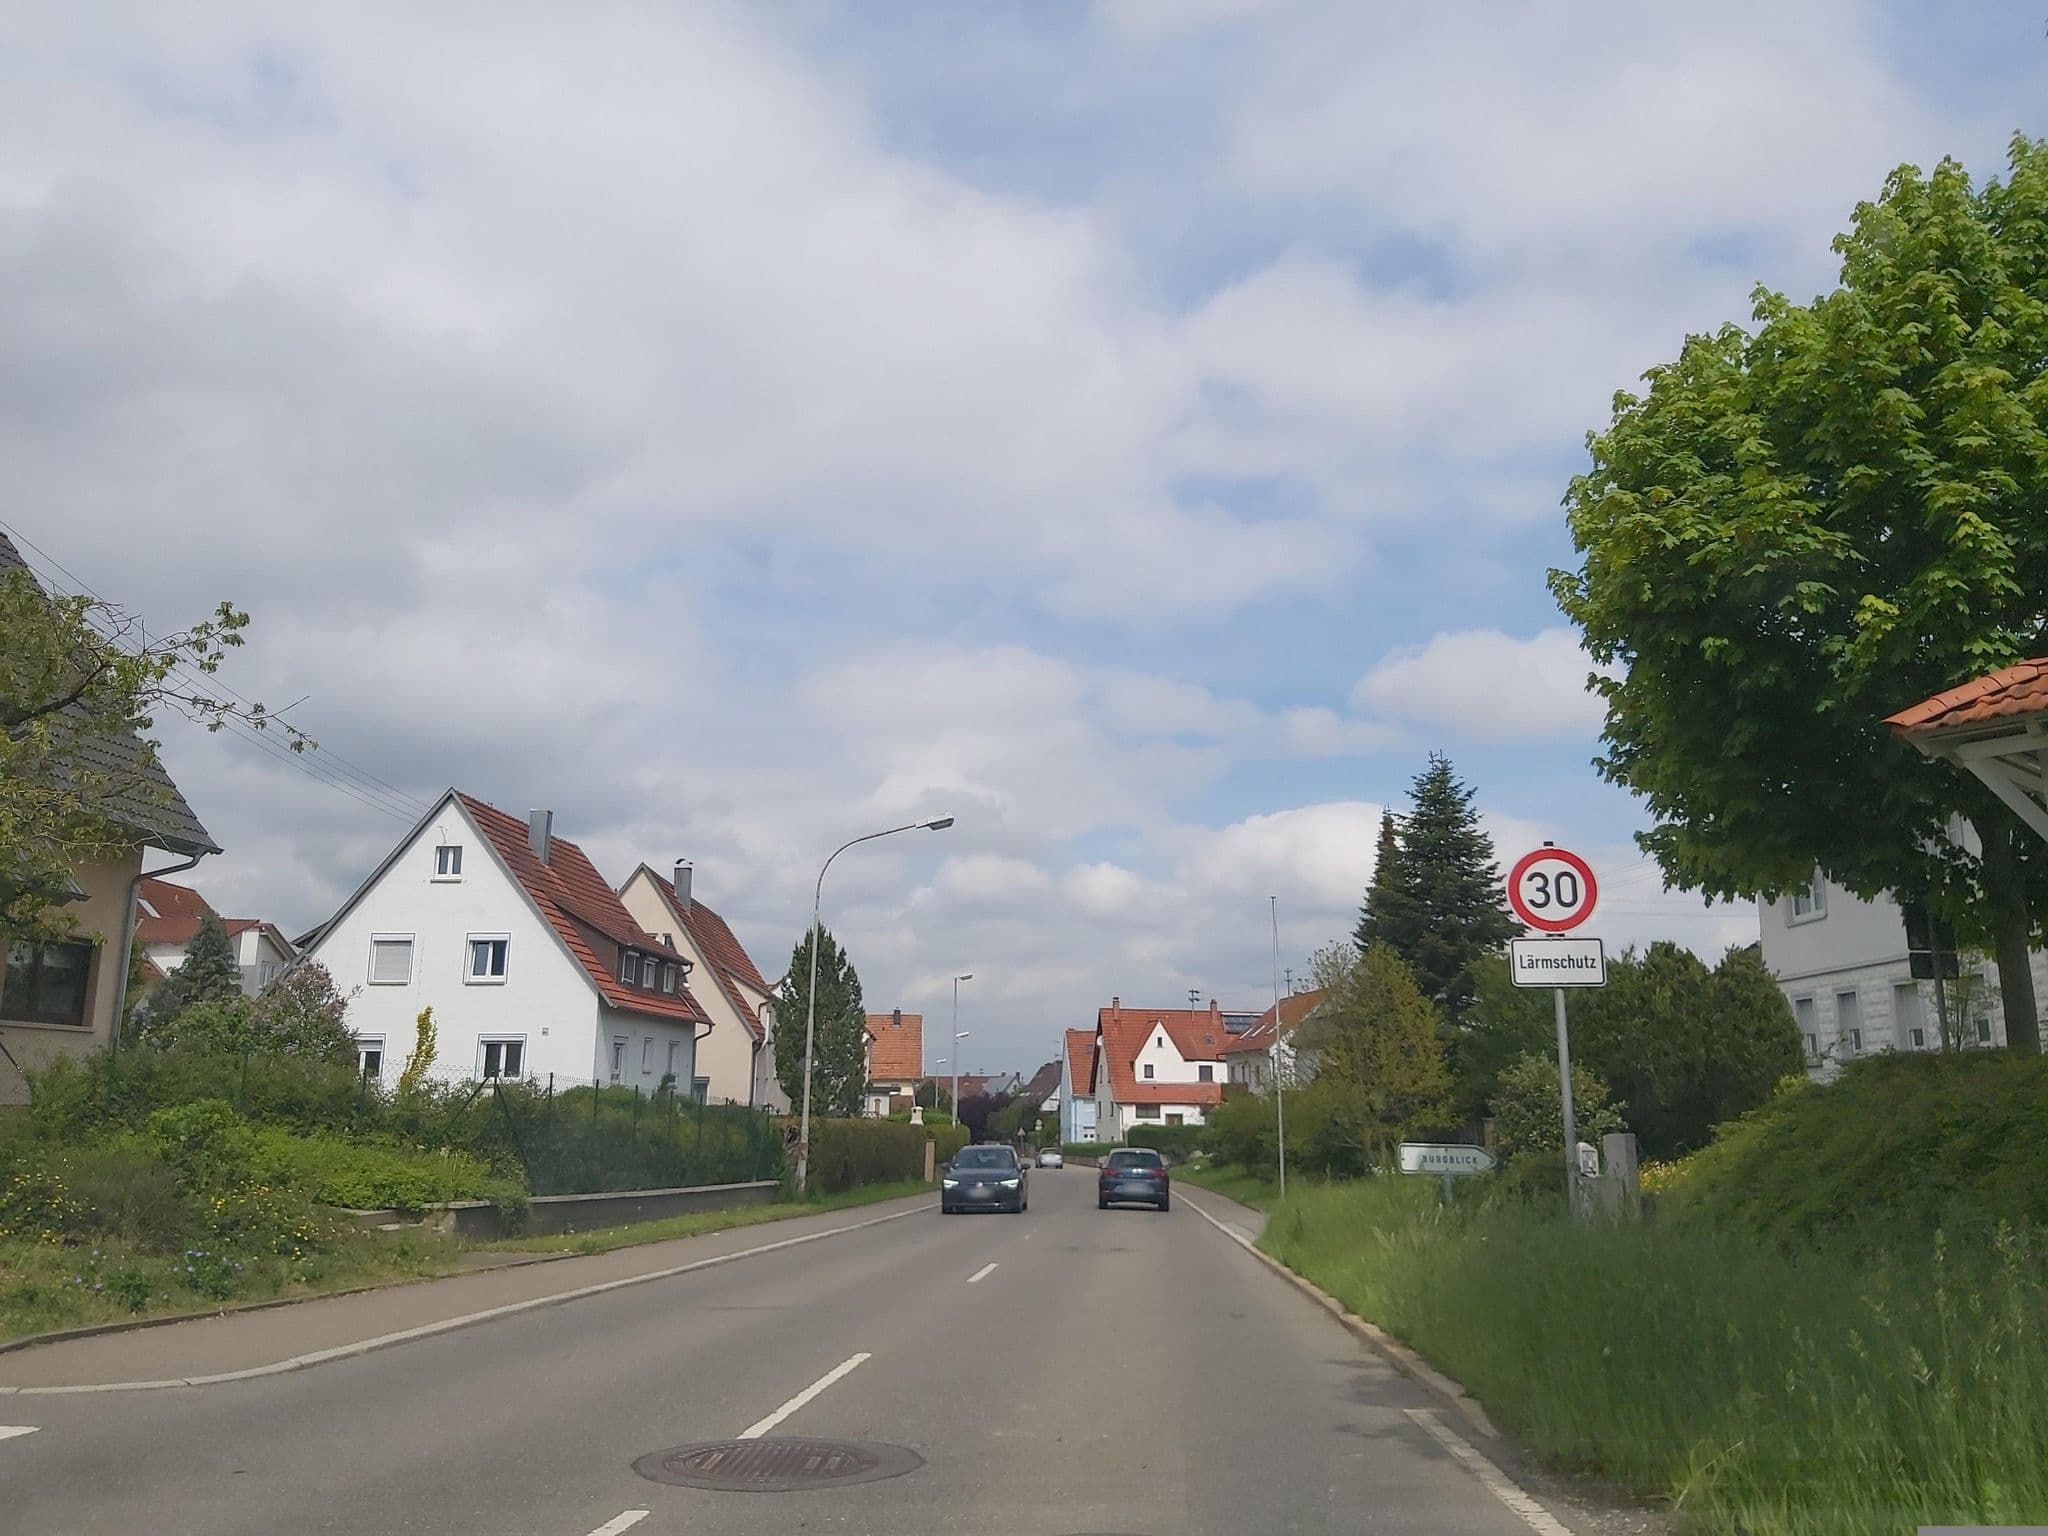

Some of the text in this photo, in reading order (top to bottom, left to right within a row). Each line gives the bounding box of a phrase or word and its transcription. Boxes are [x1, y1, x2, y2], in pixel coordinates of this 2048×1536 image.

[1527, 871, 1578, 908] 30
[1519, 954, 1597, 969] Lärmschutz
[1422, 1155, 1478, 1165] BURGBLICK
